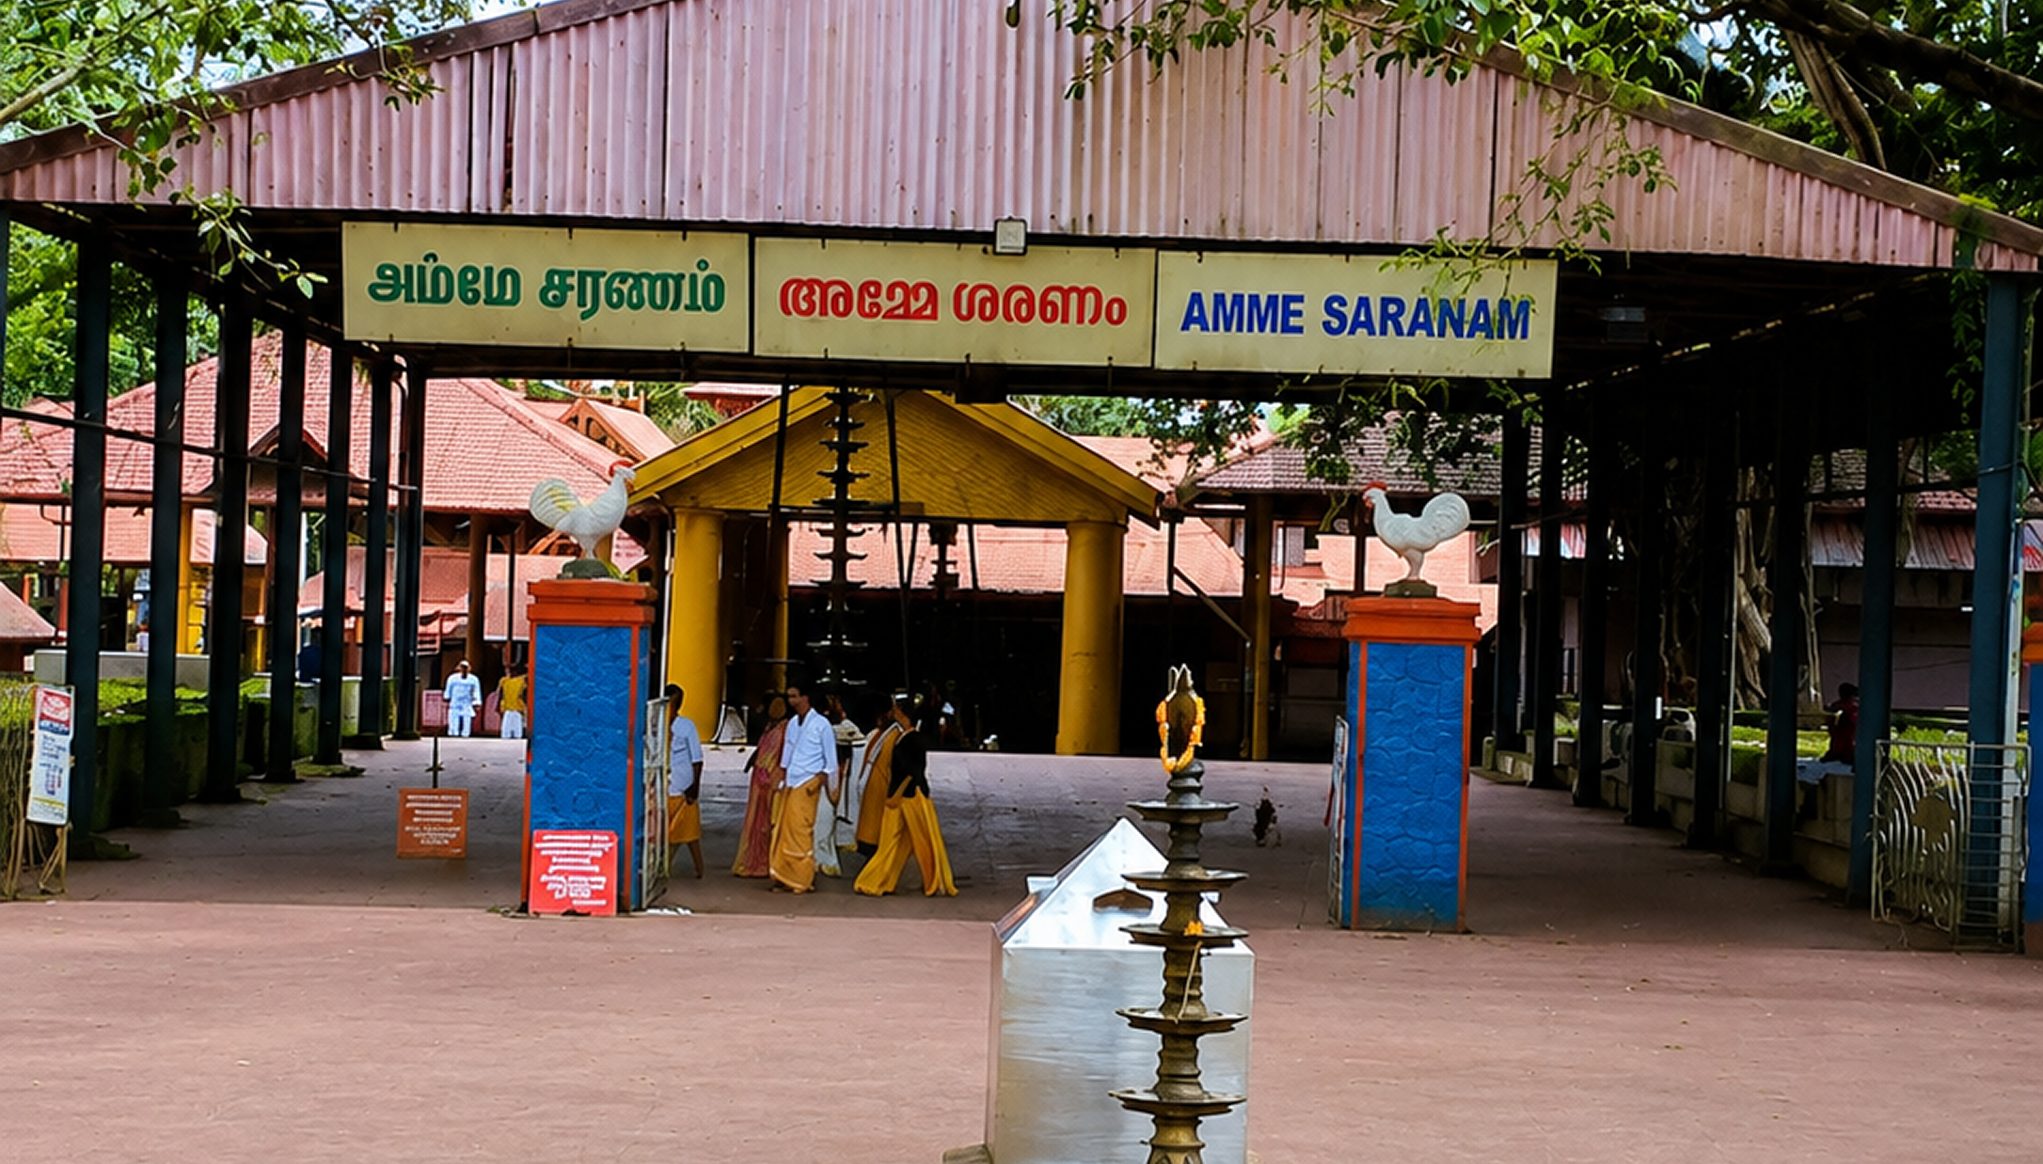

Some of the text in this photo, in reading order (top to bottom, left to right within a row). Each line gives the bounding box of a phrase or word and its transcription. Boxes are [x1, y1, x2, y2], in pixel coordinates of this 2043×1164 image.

[367, 252, 725, 321] அம்மே சரணம்
[779, 277, 1127, 326] അമ്മേ ശരണം
[1180, 291, 1531, 340] AMME SARANAM
